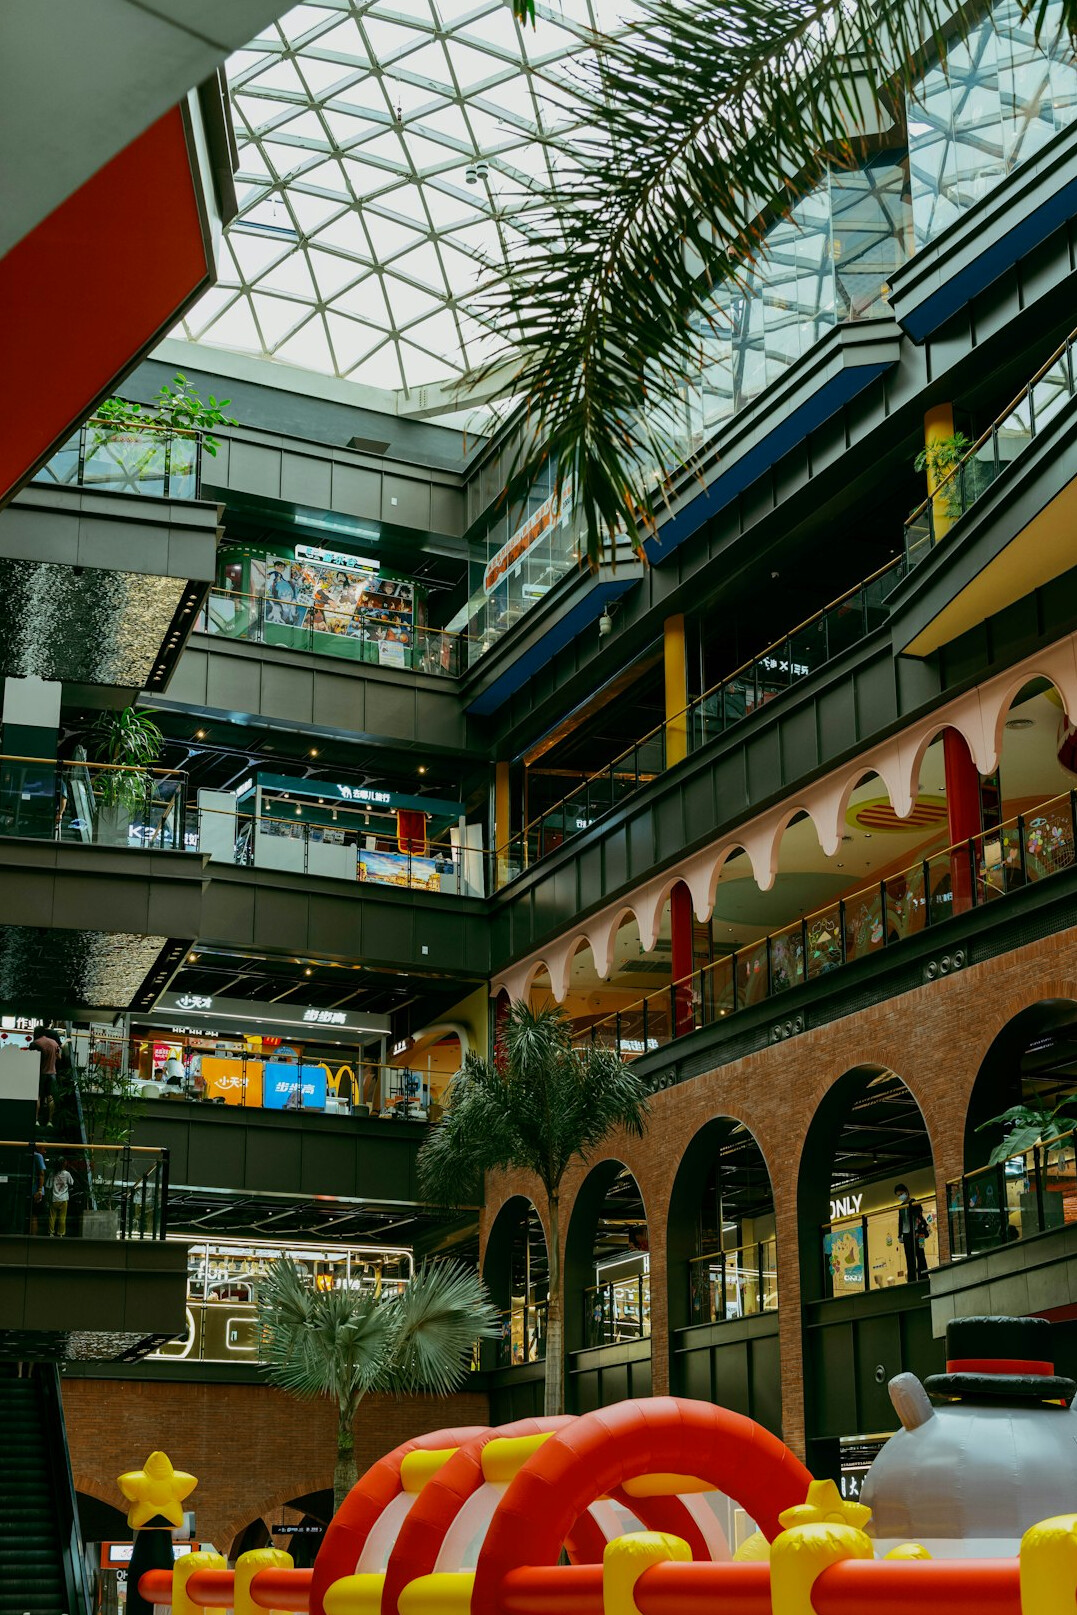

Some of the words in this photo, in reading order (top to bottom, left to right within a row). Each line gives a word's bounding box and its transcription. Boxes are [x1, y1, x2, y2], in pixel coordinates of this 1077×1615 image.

[176, 995, 213, 1009] 小天才
[303, 1009, 347, 1025] 步步高
[214, 1076, 250, 1090] 小天才
[275, 1081, 316, 1095] 步步高
[829, 1193, 863, 1220] ONLY
